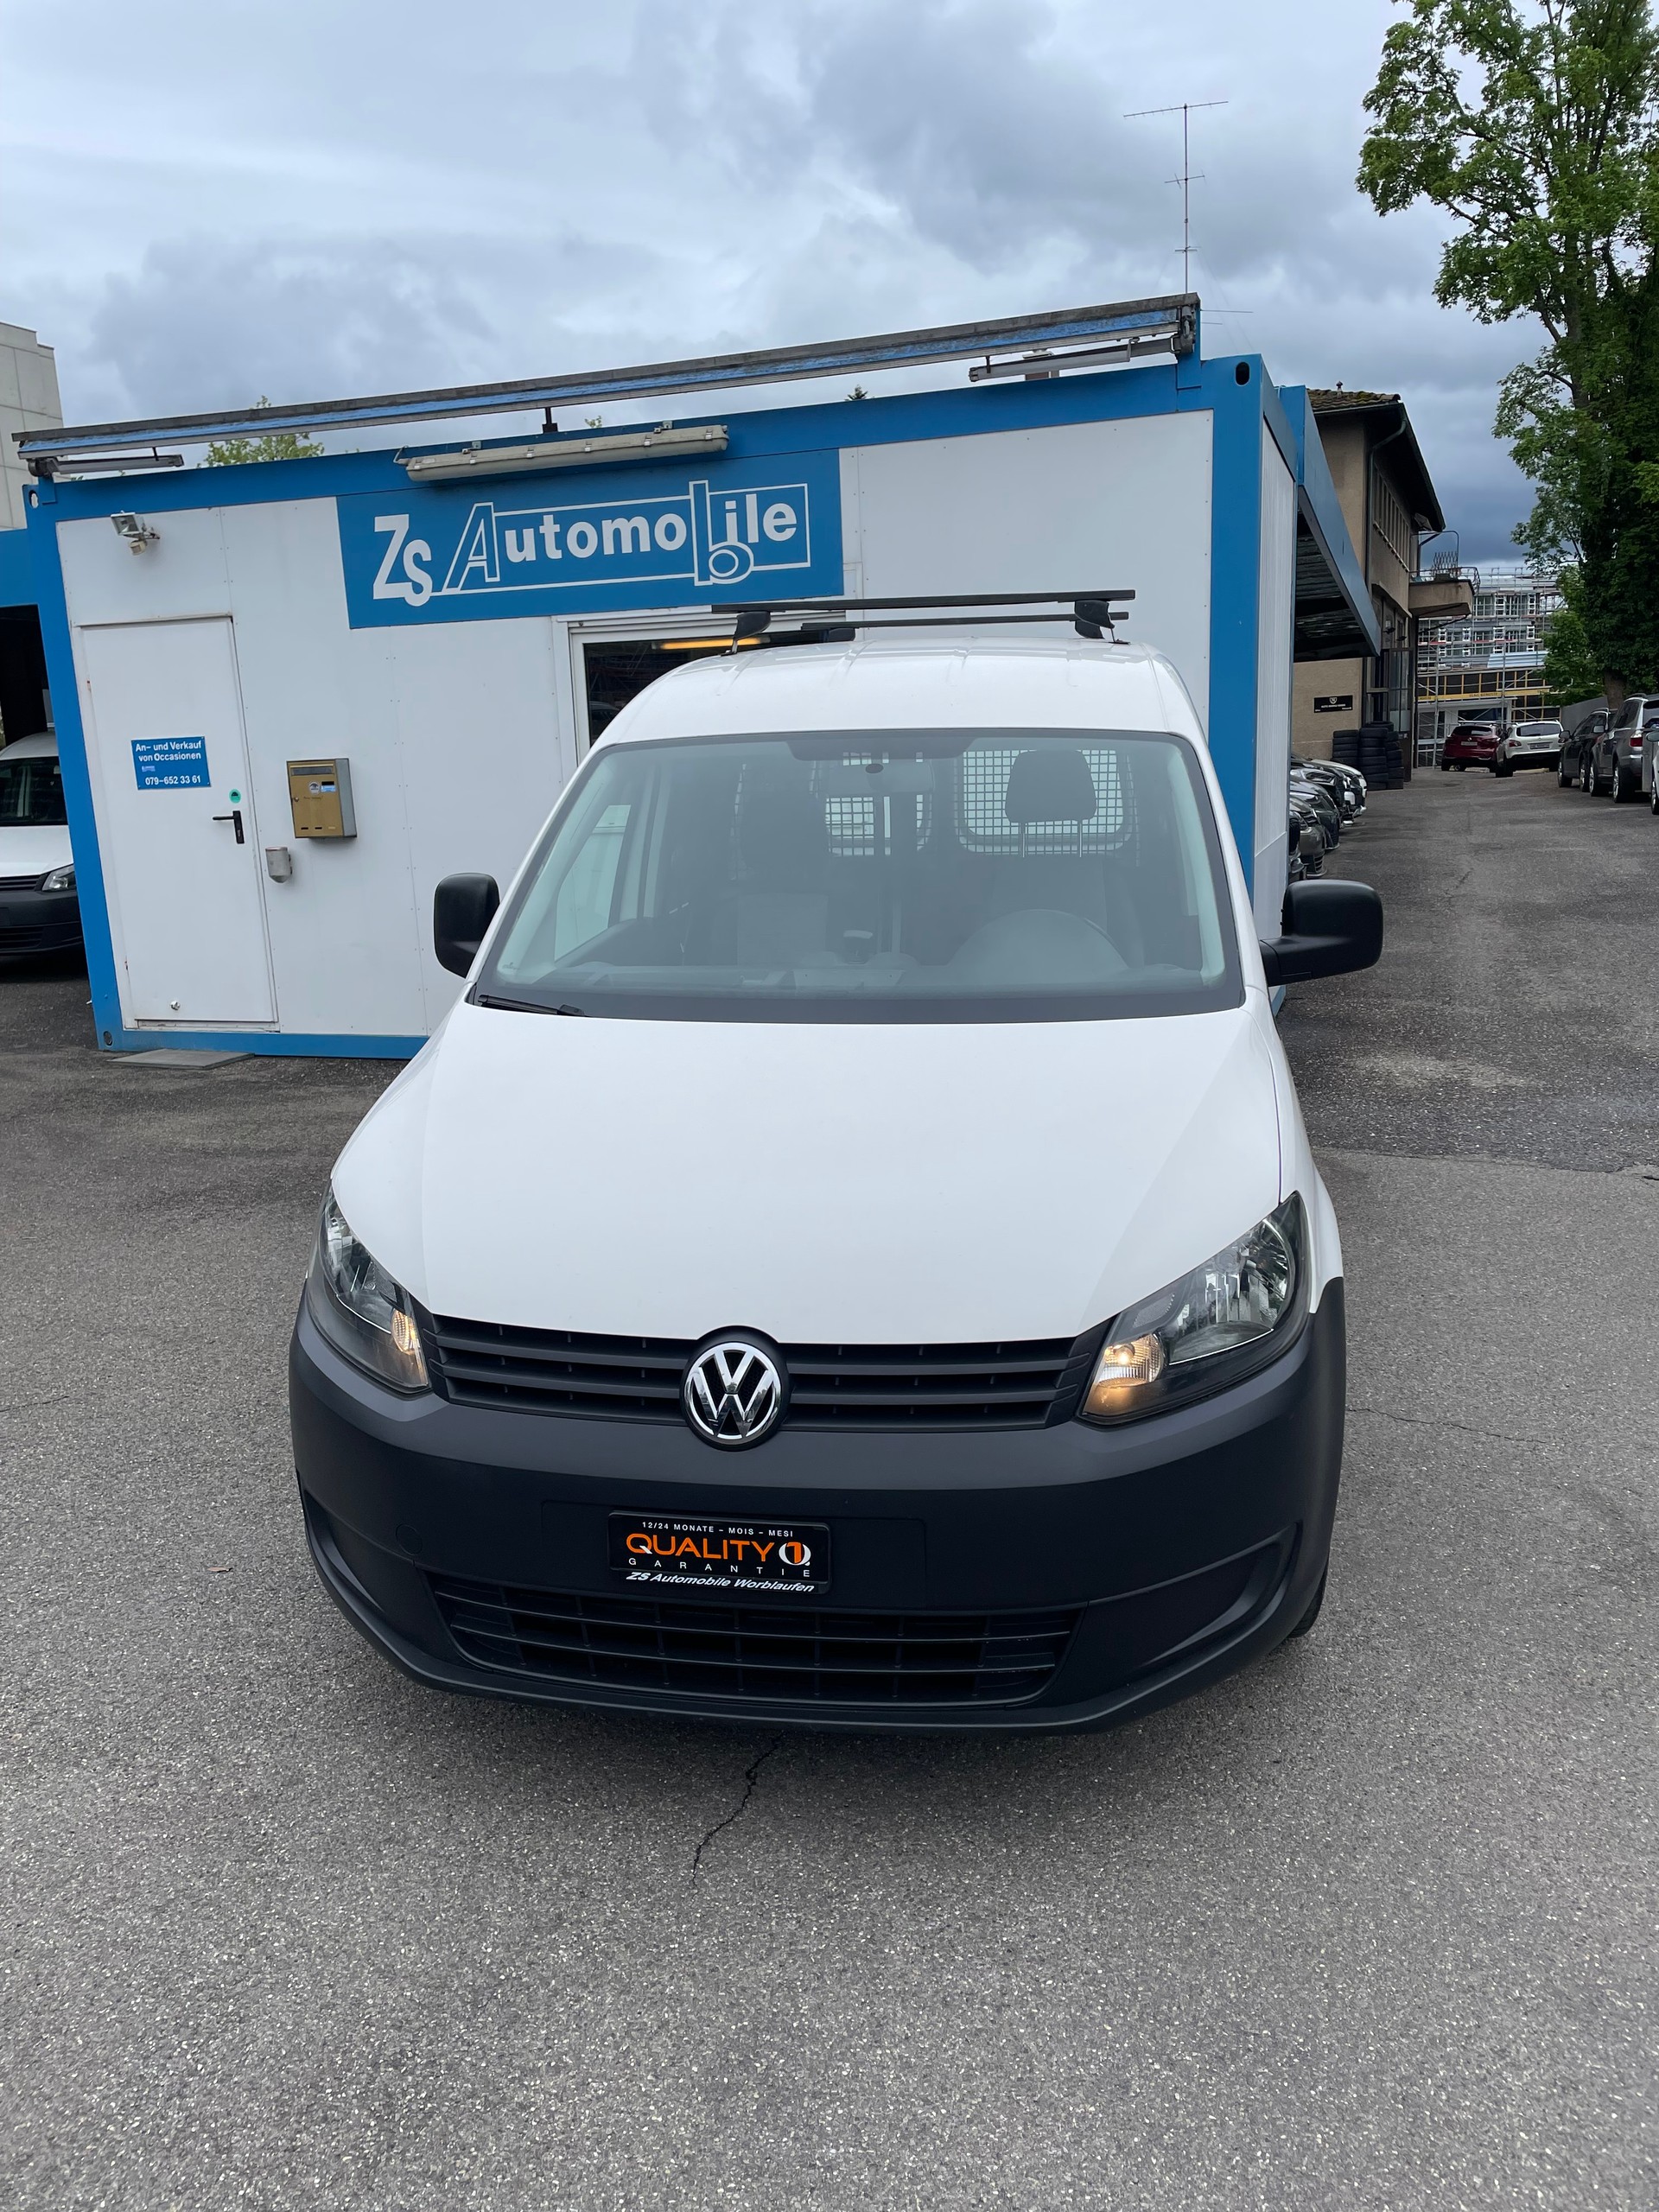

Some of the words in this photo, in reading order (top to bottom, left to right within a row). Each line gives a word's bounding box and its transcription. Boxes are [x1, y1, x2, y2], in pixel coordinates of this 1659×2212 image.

[373, 513, 432, 607] Zs
[442, 480, 798, 594] Automobile
[153, 741, 168, 751] und
[169, 740, 201, 750] Verkauf
[154, 752, 201, 761] Occasionen
[145, 776, 178, 785] 079-652
[180, 775, 190, 784] 33
[192, 775, 201, 784] 61
[684, 1342, 781, 1445] VW
[674, 1524, 715, 1533] MONATE
[626, 1533, 775, 1562] QUALITY
[626, 1571, 651, 1581] ZS
[650, 1573, 732, 1587] Automobile
[734, 1579, 815, 1592] Worblaufen
